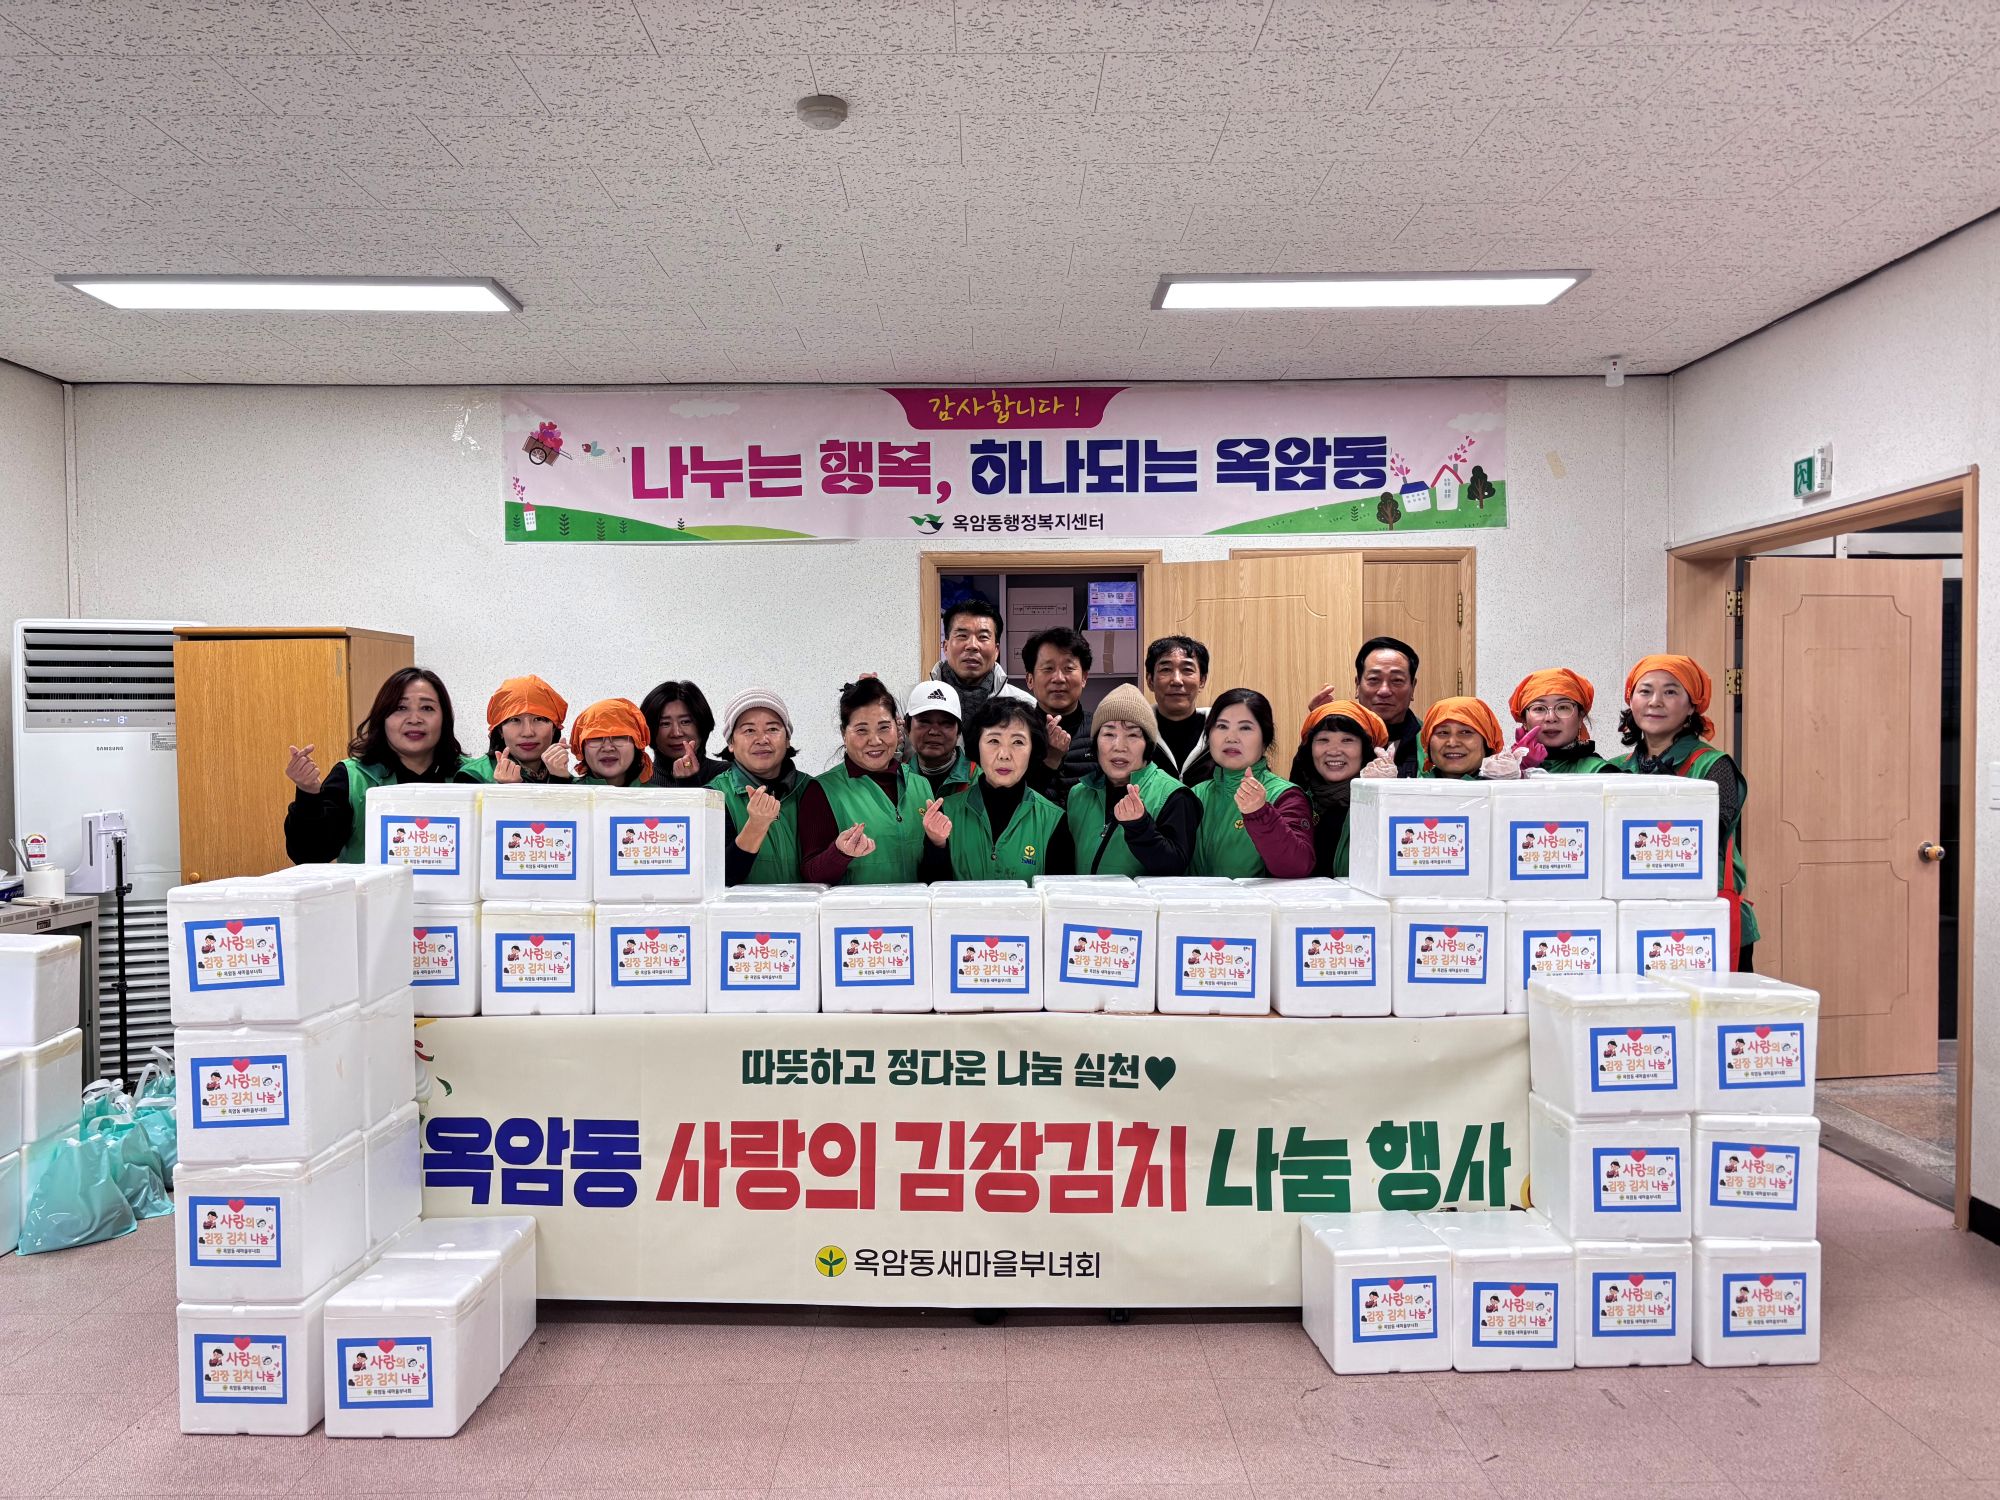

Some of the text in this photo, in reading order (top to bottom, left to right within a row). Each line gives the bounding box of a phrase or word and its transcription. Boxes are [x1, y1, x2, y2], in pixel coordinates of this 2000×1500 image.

[929, 390, 1064, 423] 감사합니다
[631, 436, 1388, 504] 나누는 행복, 하나되는 옥암동
[952, 513, 1104, 532] 옥암동행정복지센터
[407, 830, 437, 843] 사랑의
[523, 835, 553, 848] 사랑의
[637, 830, 667, 843] 사랑의
[1416, 830, 1446, 843] 사랑의
[1537, 835, 1566, 847] 사랑의
[1649, 834, 1679, 847] 사랑의
[394, 845, 448, 856] 김장 김치 나눔
[509, 850, 565, 861] 김장 김치 나눔
[623, 845, 679, 856] 김장 김치 나눔
[1402, 845, 1458, 856] 김장 김치 나눔
[1523, 850, 1578, 861] 김장 김치 나눔
[1635, 849, 1691, 860] 김장 김치 나눔
[218, 935, 255, 951] 사랑의
[638, 941, 667, 953] 사랑의
[861, 941, 891, 953] 사랑의
[1088, 939, 1119, 955] 사랑의
[1323, 941, 1352, 954] 사랑의
[1436, 938, 1465, 952] 사랑의
[1664, 943, 1693, 956] 사랑의
[522, 947, 552, 960] 사랑의
[748, 946, 777, 959] 사랑의
[977, 949, 1007, 962] 사랑의
[1550, 944, 1578, 956] 사랑의
[203, 952, 270, 968] 김장 김치 나눔
[413, 956, 448, 967] 김치 나눔
[624, 956, 679, 967] 김장 김치 나눔
[848, 956, 903, 967] 김장 김치 나눔
[1074, 954, 1129, 968] 김장 김치 나눔
[1203, 951, 1233, 965] 사랑의
[1309, 956, 1364, 967] 김장 김치 나눔
[1421, 954, 1476, 965] 김장 김치 나눔
[1536, 959, 1590, 970] 김장 김치 나눔
[1650, 958, 1705, 969] 김장 김치 나눔
[509, 962, 564, 973] 김장 김치 나눔
[734, 961, 789, 972] 김장 김치 나눔
[964, 964, 1018, 975] 김장 김치 나눔
[1189, 966, 1244, 978] 김장 김치 나눔
[1619, 1042, 1651, 1056] 사랑의
[1747, 1039, 1779, 1053] 사랑의
[1605, 1058, 1665, 1071] 김장 김치 나눔
[1733, 1055, 1793, 1068] 김장 김치 나눔
[742, 1048, 1139, 1089] 따뜻하고 정다운 나눔 실천
[224, 1073, 260, 1089] 사랑의
[208, 1091, 275, 1105] 김장 김치 나눔
[423, 1116, 1511, 1213] 옥암동 사랑의 김장김치 나눔 행사
[1623, 1163, 1655, 1177] 사랑의
[1741, 1158, 1774, 1174] 사랑의
[1608, 1179, 1668, 1191] 김장 김치 나눔
[1725, 1175, 1786, 1188] 김장 김치 나눔
[220, 1213, 254, 1229] 사랑의
[204, 1231, 268, 1245] 김장 김치 나눔
[853, 1248, 1100, 1279] 옥암동새마을부녀회
[1381, 1292, 1412, 1306] 사랑의
[1621, 1287, 1652, 1301] 사랑의
[1751, 1288, 1782, 1302] 사랑의
[1502, 1298, 1533, 1312] 사랑의
[1606, 1304, 1664, 1315] 김장 김치 나눔
[1737, 1304, 1794, 1316] 김장 김치 나눔
[1366, 1308, 1425, 1321] 김장 김치 나눔
[1486, 1314, 1546, 1326] 김장 김치 나눔
[226, 1351, 260, 1367] 사랑의
[370, 1354, 405, 1369] 사랑의
[210, 1369, 274, 1382] 김장 김치 나눔
[354, 1372, 419, 1386] 김장 김치 나눔
